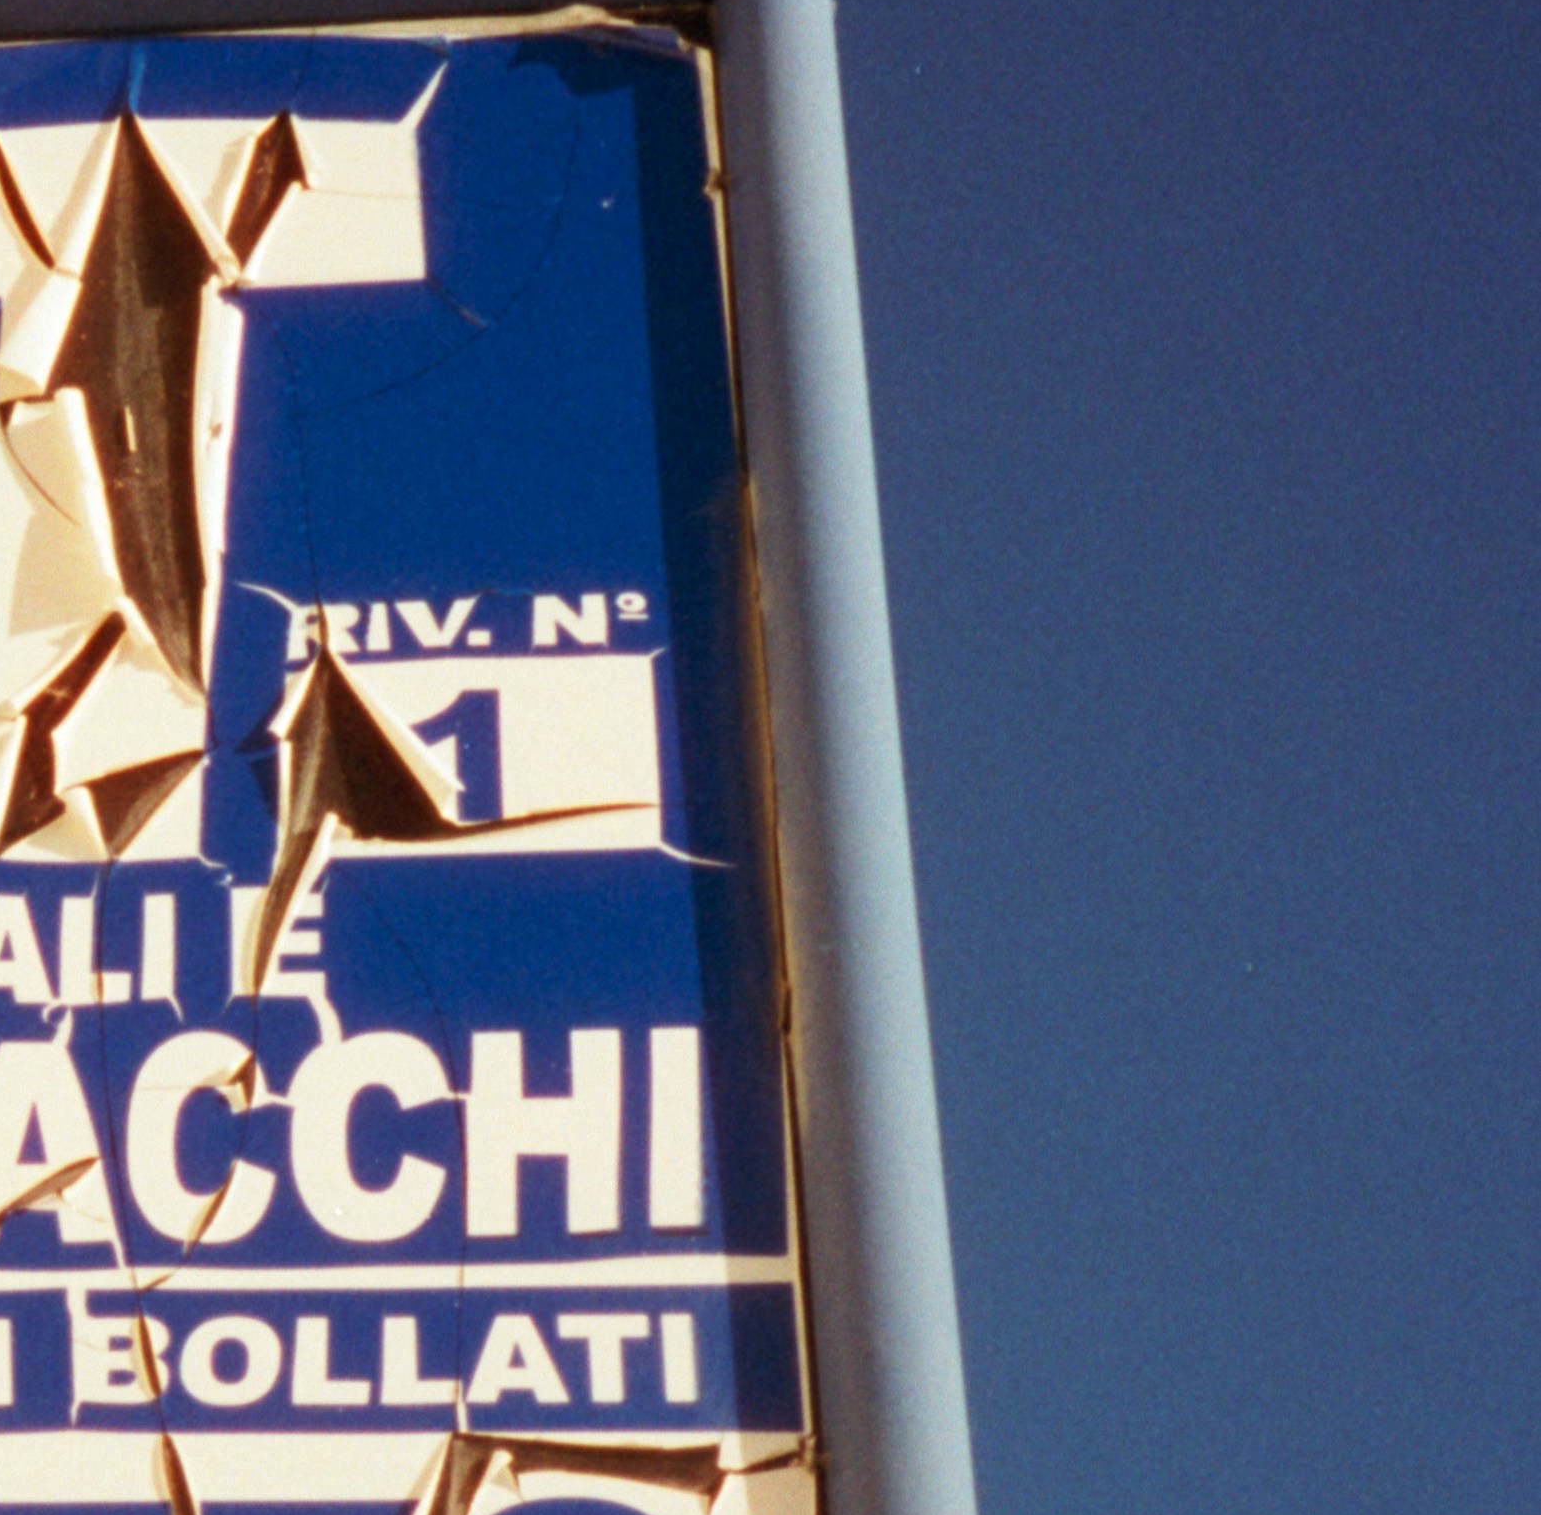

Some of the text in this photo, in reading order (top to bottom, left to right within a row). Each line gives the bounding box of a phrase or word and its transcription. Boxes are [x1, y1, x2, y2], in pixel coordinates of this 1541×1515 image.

[286, 599, 492, 662] RIV.
[230, 886, 326, 997] E
[72, 1313, 700, 1407] BOLLATI
